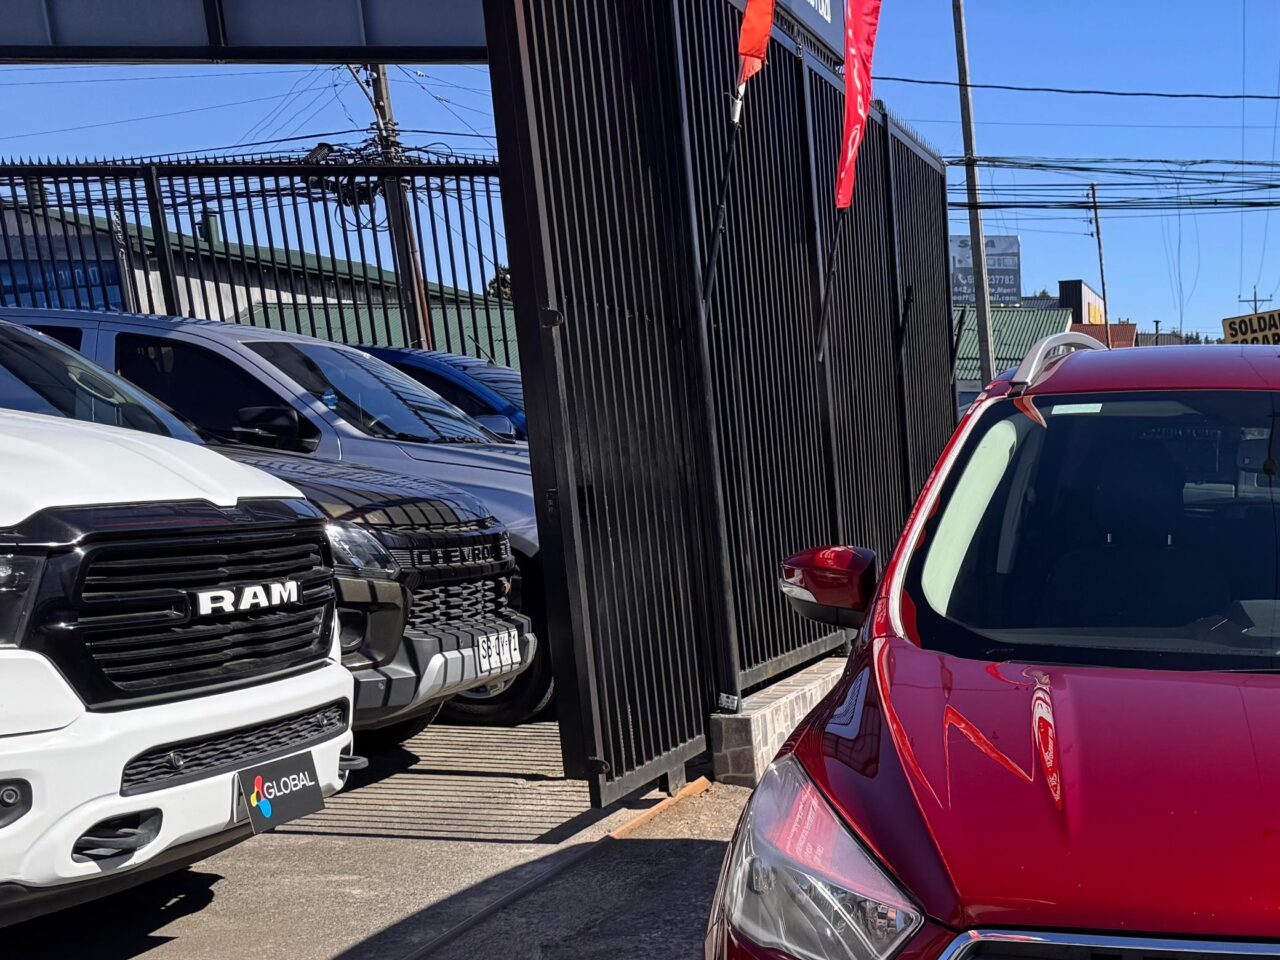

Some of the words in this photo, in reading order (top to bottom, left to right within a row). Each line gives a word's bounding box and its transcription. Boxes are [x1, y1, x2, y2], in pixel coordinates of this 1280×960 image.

[414, 539, 511, 567] CHEVROET
[199, 580, 298, 615] RAM
[263, 771, 315, 799] GLOBAL
